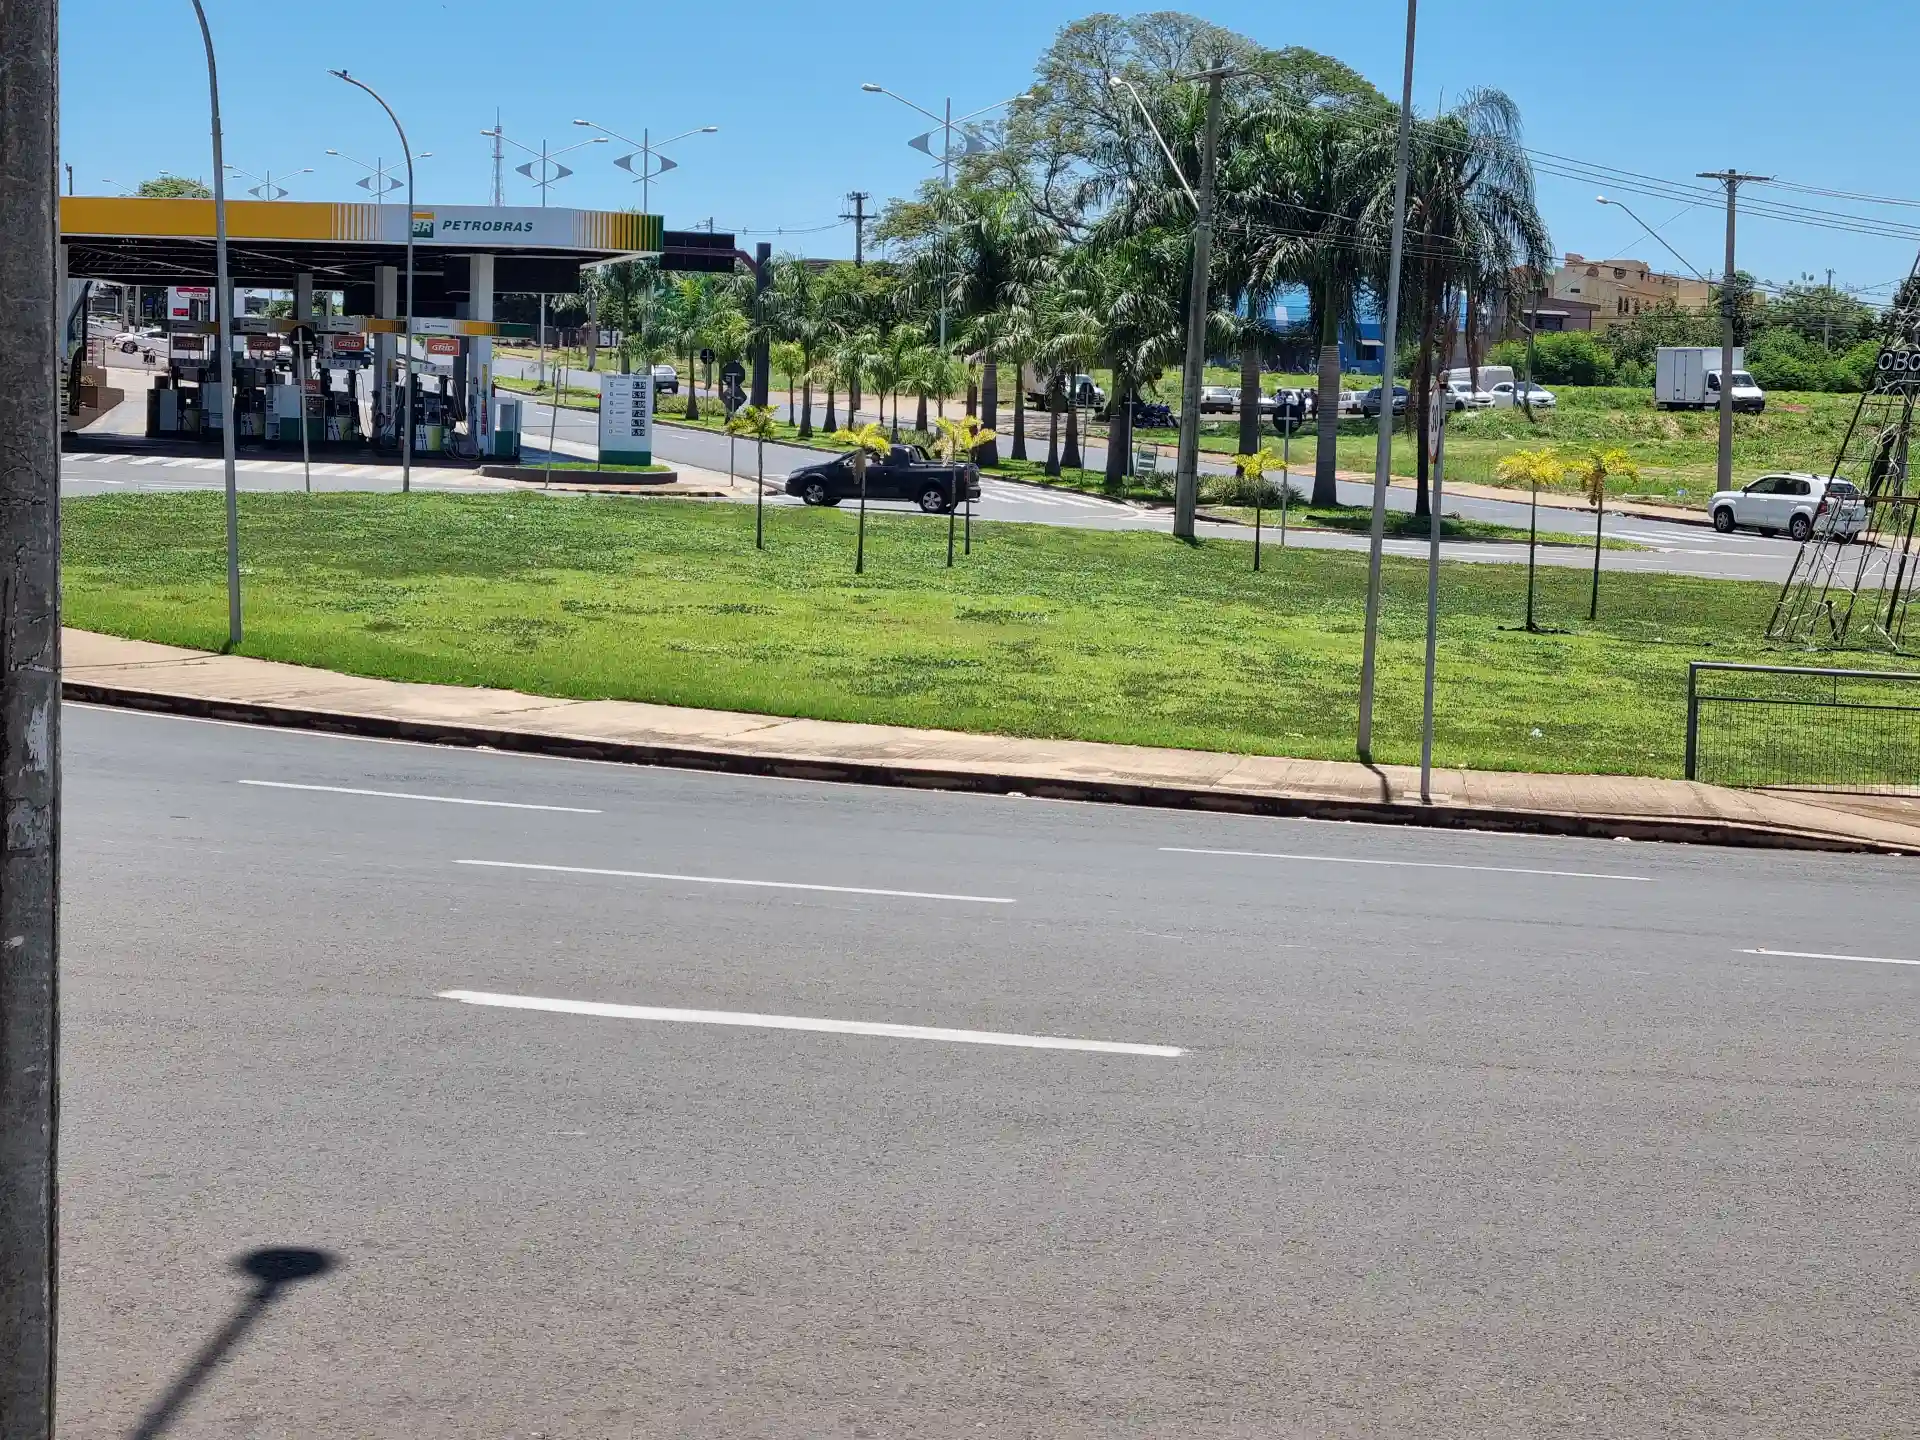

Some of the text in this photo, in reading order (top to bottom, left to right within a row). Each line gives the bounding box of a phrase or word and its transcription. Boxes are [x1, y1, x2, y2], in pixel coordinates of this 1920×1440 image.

[412, 220, 433, 233] BR
[442, 220, 533, 232] PETROBRAS
[431, 342, 455, 353] GRID
